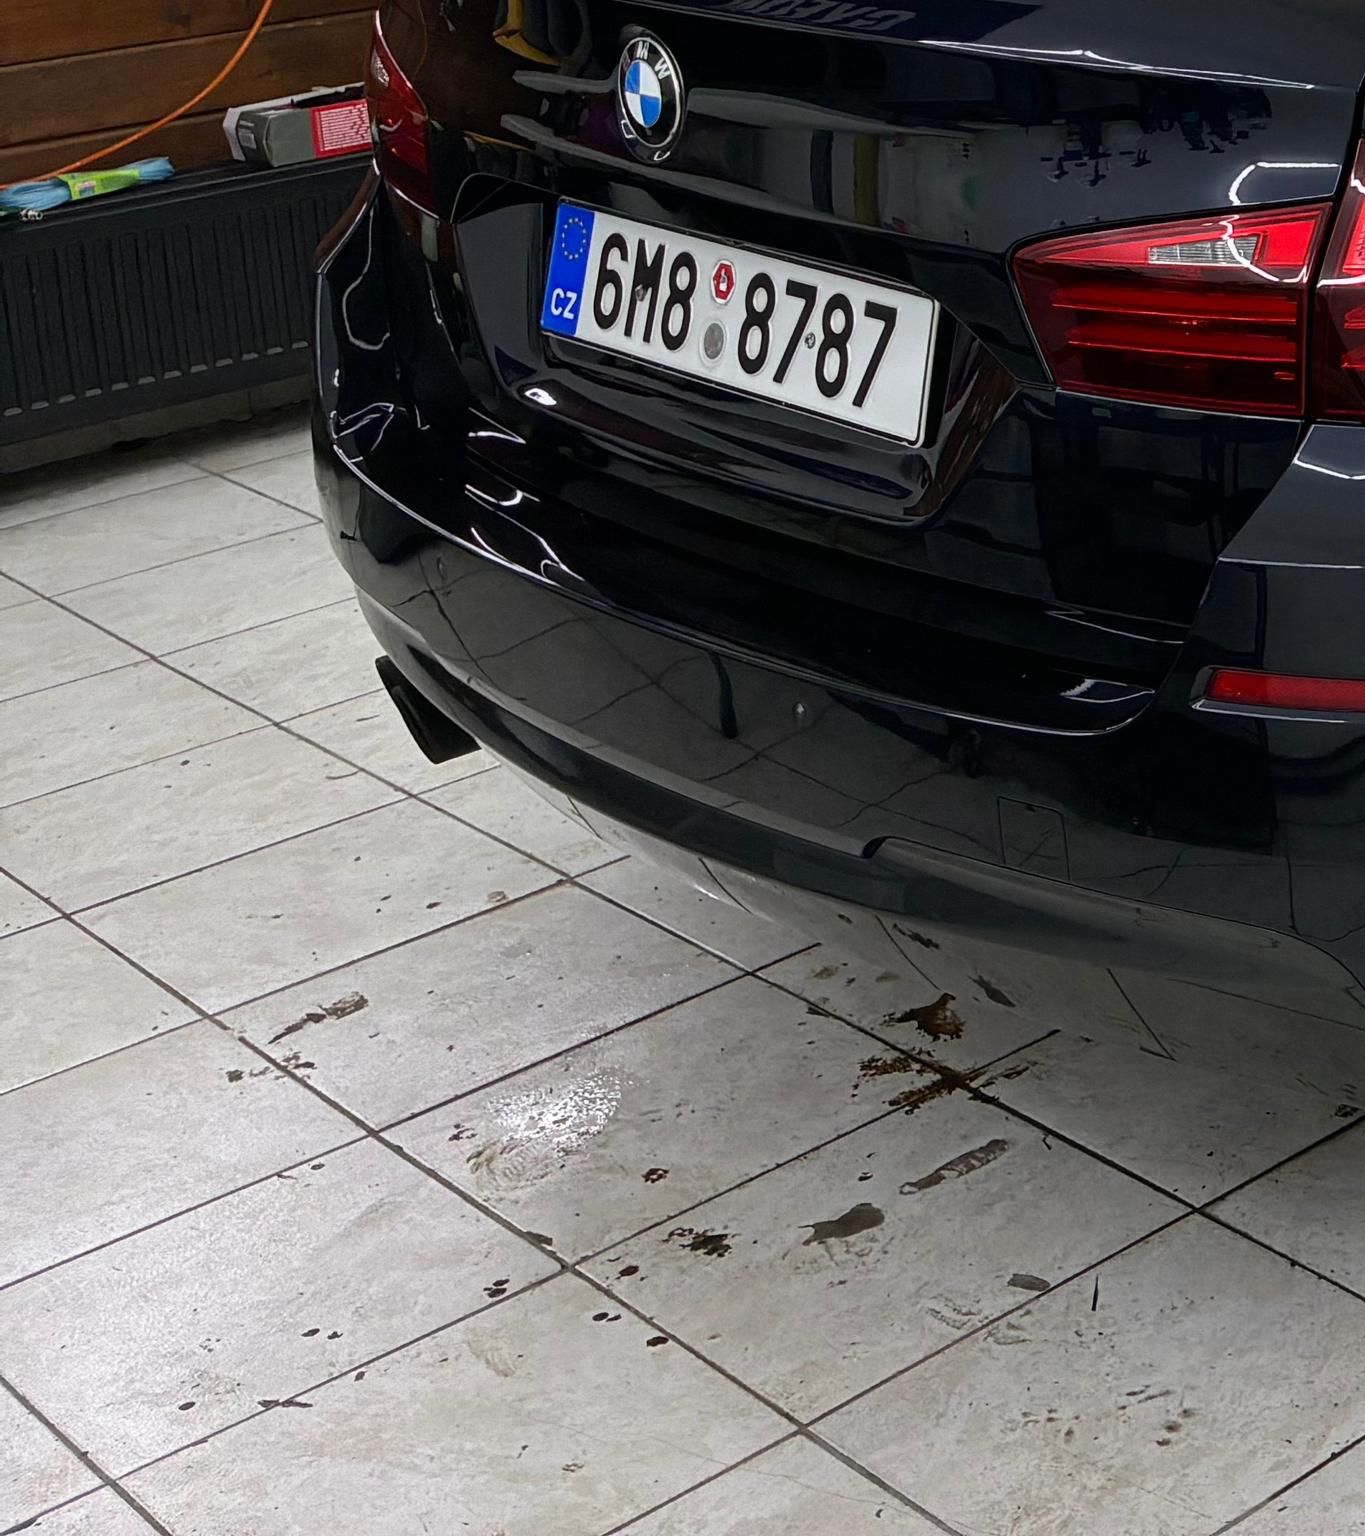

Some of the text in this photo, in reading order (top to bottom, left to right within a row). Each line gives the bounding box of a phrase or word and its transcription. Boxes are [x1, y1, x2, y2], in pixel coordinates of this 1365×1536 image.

[622, 40, 671, 80] BMW
[549, 286, 578, 322] CZ
[592, 232, 898, 408] 6M8 8787
